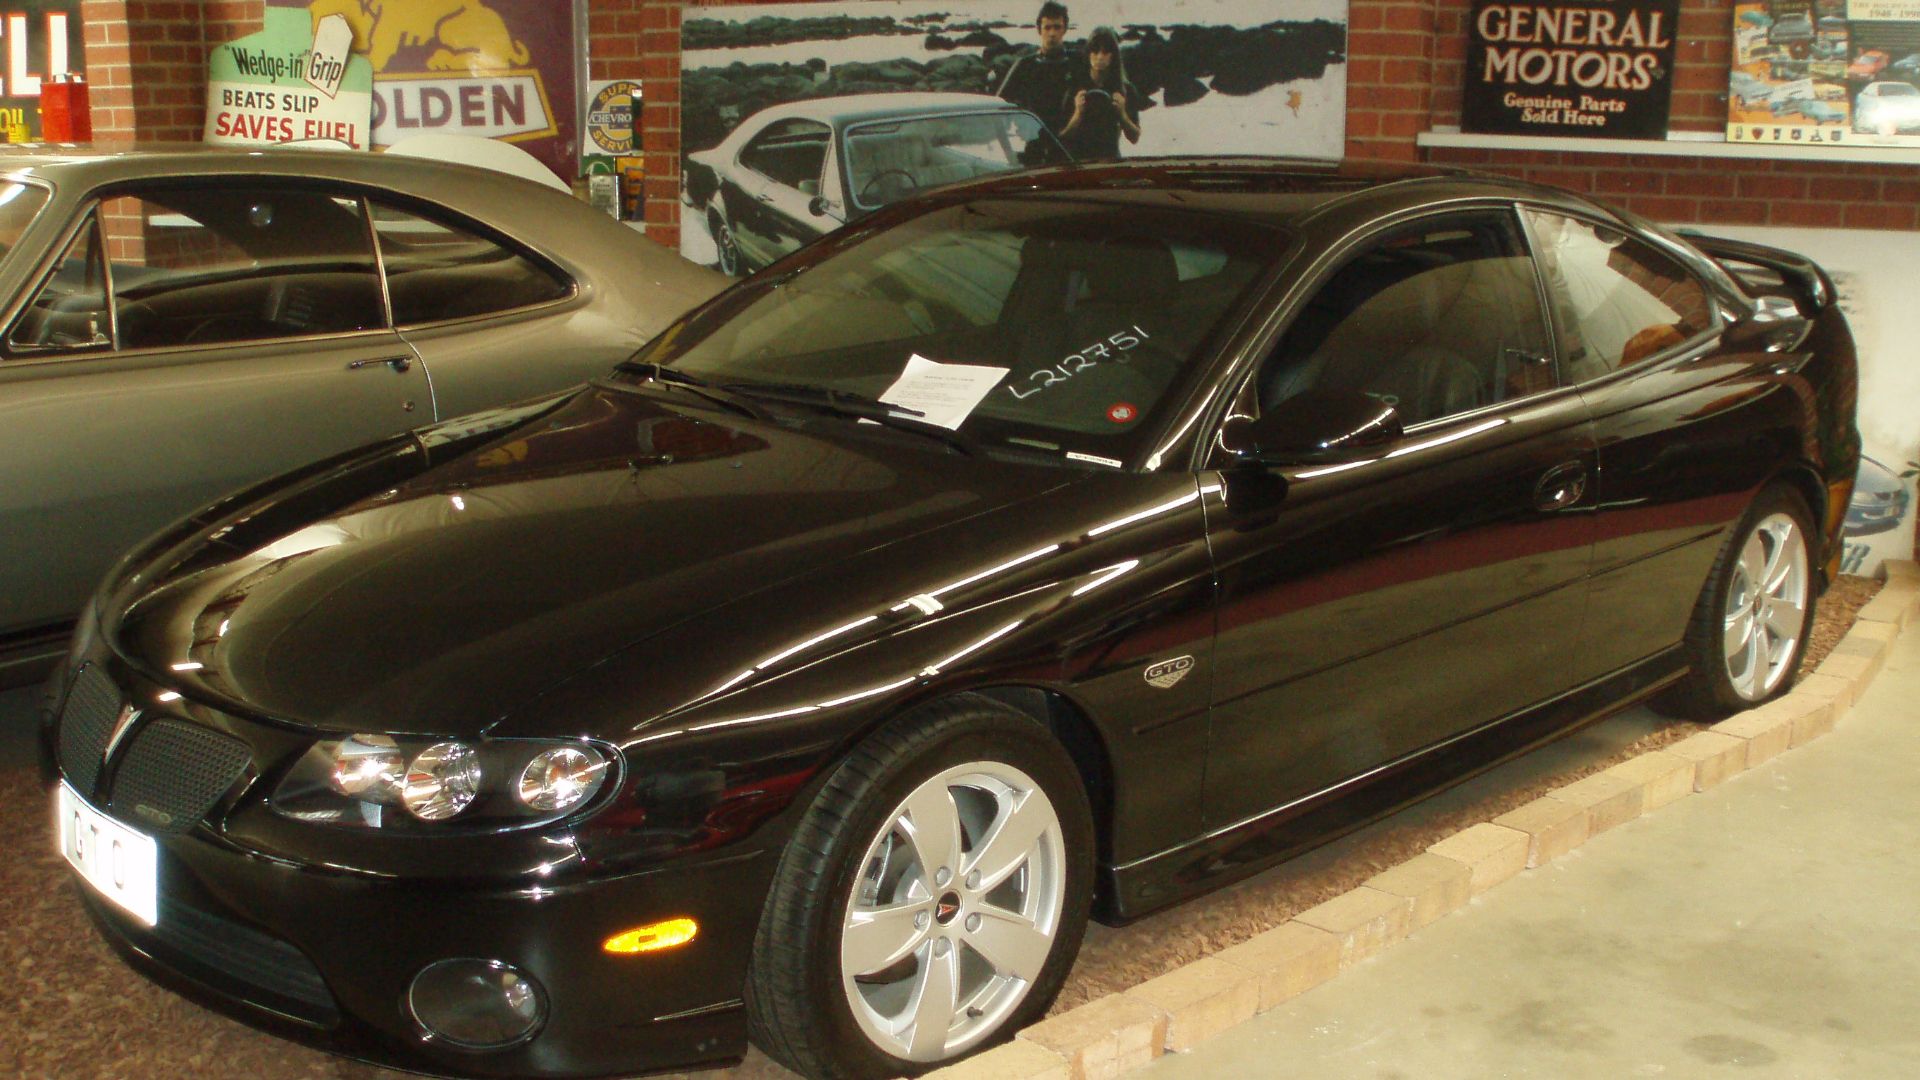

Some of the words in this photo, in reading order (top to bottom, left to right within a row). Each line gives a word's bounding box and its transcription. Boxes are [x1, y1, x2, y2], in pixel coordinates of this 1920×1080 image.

[1477, 5, 1670, 48] GENERAL
[310, 51, 342, 88] Grip
[1483, 46, 1657, 90] MOTORS
[222, 89, 275, 110] BEATS
[282, 94, 319, 113] SLIP
[1503, 92, 1573, 110] Genuine
[1580, 95, 1627, 112] Parts
[1521, 107, 1559, 125] Sold
[1563, 110, 1606, 127] Here
[215, 112, 294, 143] SAVES
[304, 119, 361, 149] FUEL
[1008, 324, 1150, 400] L212751
[1149, 659, 1189, 678] GTO
[74, 810, 126, 891] GTO
